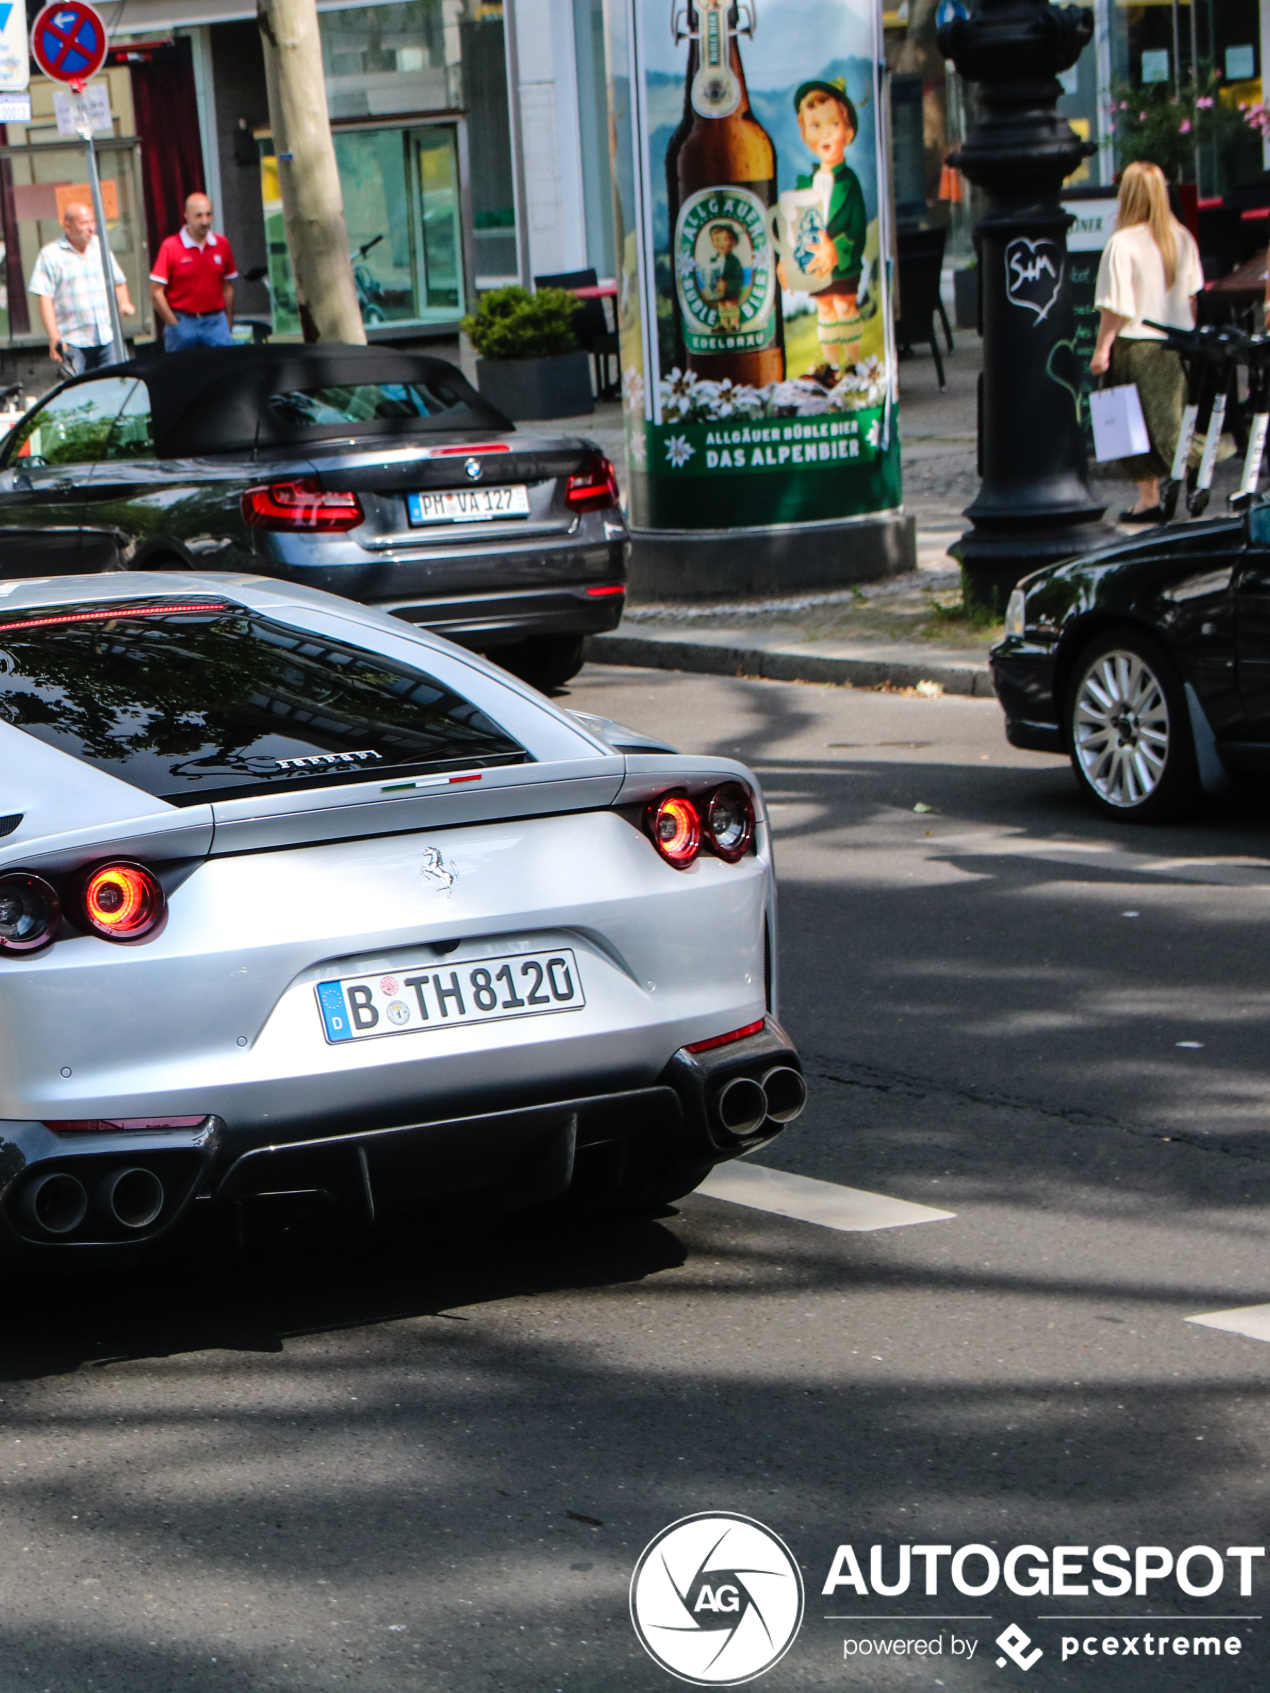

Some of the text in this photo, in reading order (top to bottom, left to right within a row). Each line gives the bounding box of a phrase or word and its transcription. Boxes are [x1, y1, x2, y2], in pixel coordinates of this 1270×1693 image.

[741, 273, 767, 319] BIER
[706, 420, 858, 445] ALLGÄUER BÜBLE BIER
[706, 439, 860, 468] DAS ALPENBIER
[457, 492, 480, 513] VA
[483, 489, 513, 511] 127
[347, 984, 379, 1030] B
[404, 971, 466, 1020] TH
[469, 957, 574, 1011] 8120
[332, 1016, 343, 1030] D
